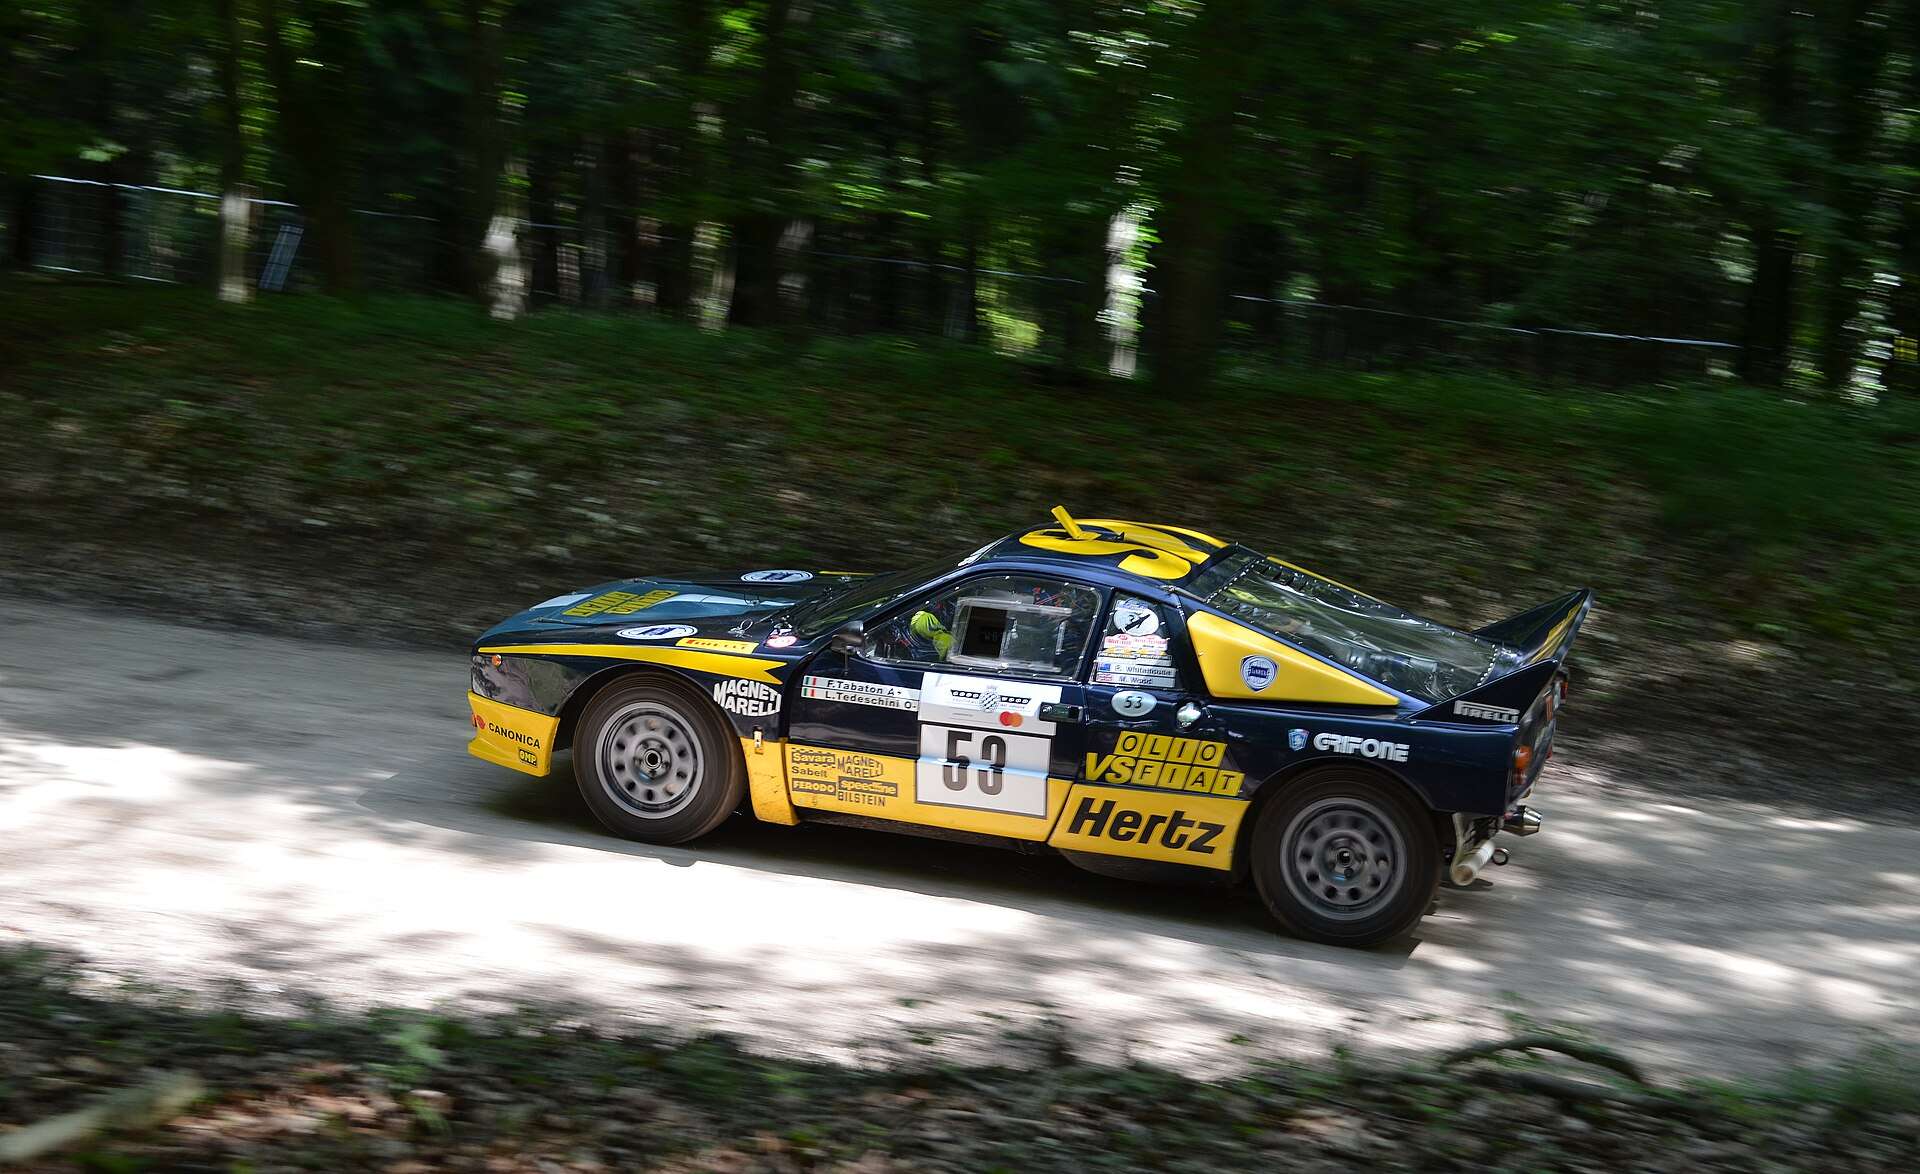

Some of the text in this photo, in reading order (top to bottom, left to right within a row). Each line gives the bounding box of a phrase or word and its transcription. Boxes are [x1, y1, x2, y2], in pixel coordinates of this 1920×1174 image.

[713, 679, 782, 705] MAGNETI
[825, 690, 900, 708] L.Tedeschini
[827, 679, 883, 695] F.Tabaton
[713, 693, 781, 717] MARELLI
[1124, 695, 1143, 709] 53
[1453, 699, 1520, 724] PIRELLI
[488, 722, 541, 750] CANONICA
[1118, 733, 1222, 763] OLIO
[1313, 732, 1410, 763] GRIFONE
[943, 729, 1007, 796] 53
[792, 780, 836, 793] FERODO
[1135, 762, 1240, 793] FIAT
[837, 791, 887, 807] BILSTEIN
[1068, 797, 1226, 855] Hertz
